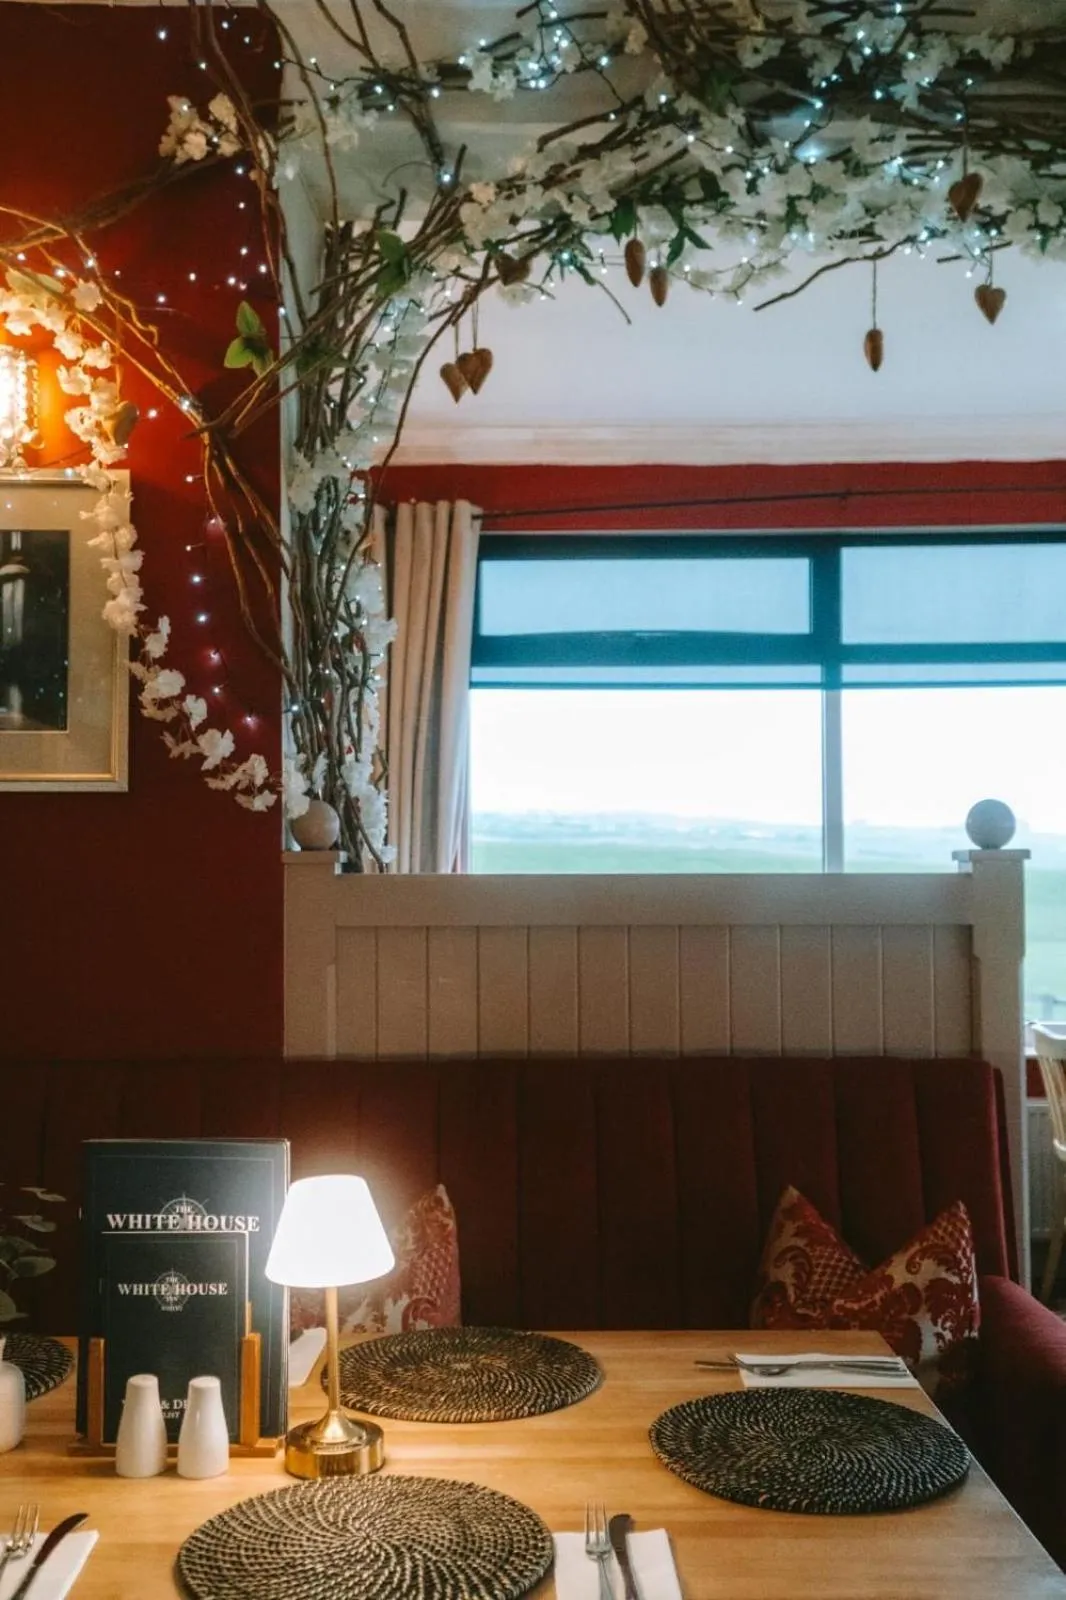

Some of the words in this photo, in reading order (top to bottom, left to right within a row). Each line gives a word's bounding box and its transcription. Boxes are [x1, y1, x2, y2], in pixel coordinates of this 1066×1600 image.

[175, 1205, 193, 1213] THE
[106, 1214, 180, 1229] WHITE
[186, 1214, 260, 1232] HOUSE
[118, 1283, 171, 1296] WHITE
[175, 1283, 228, 1296] HOUSE
[161, 1399, 171, 1410] &
